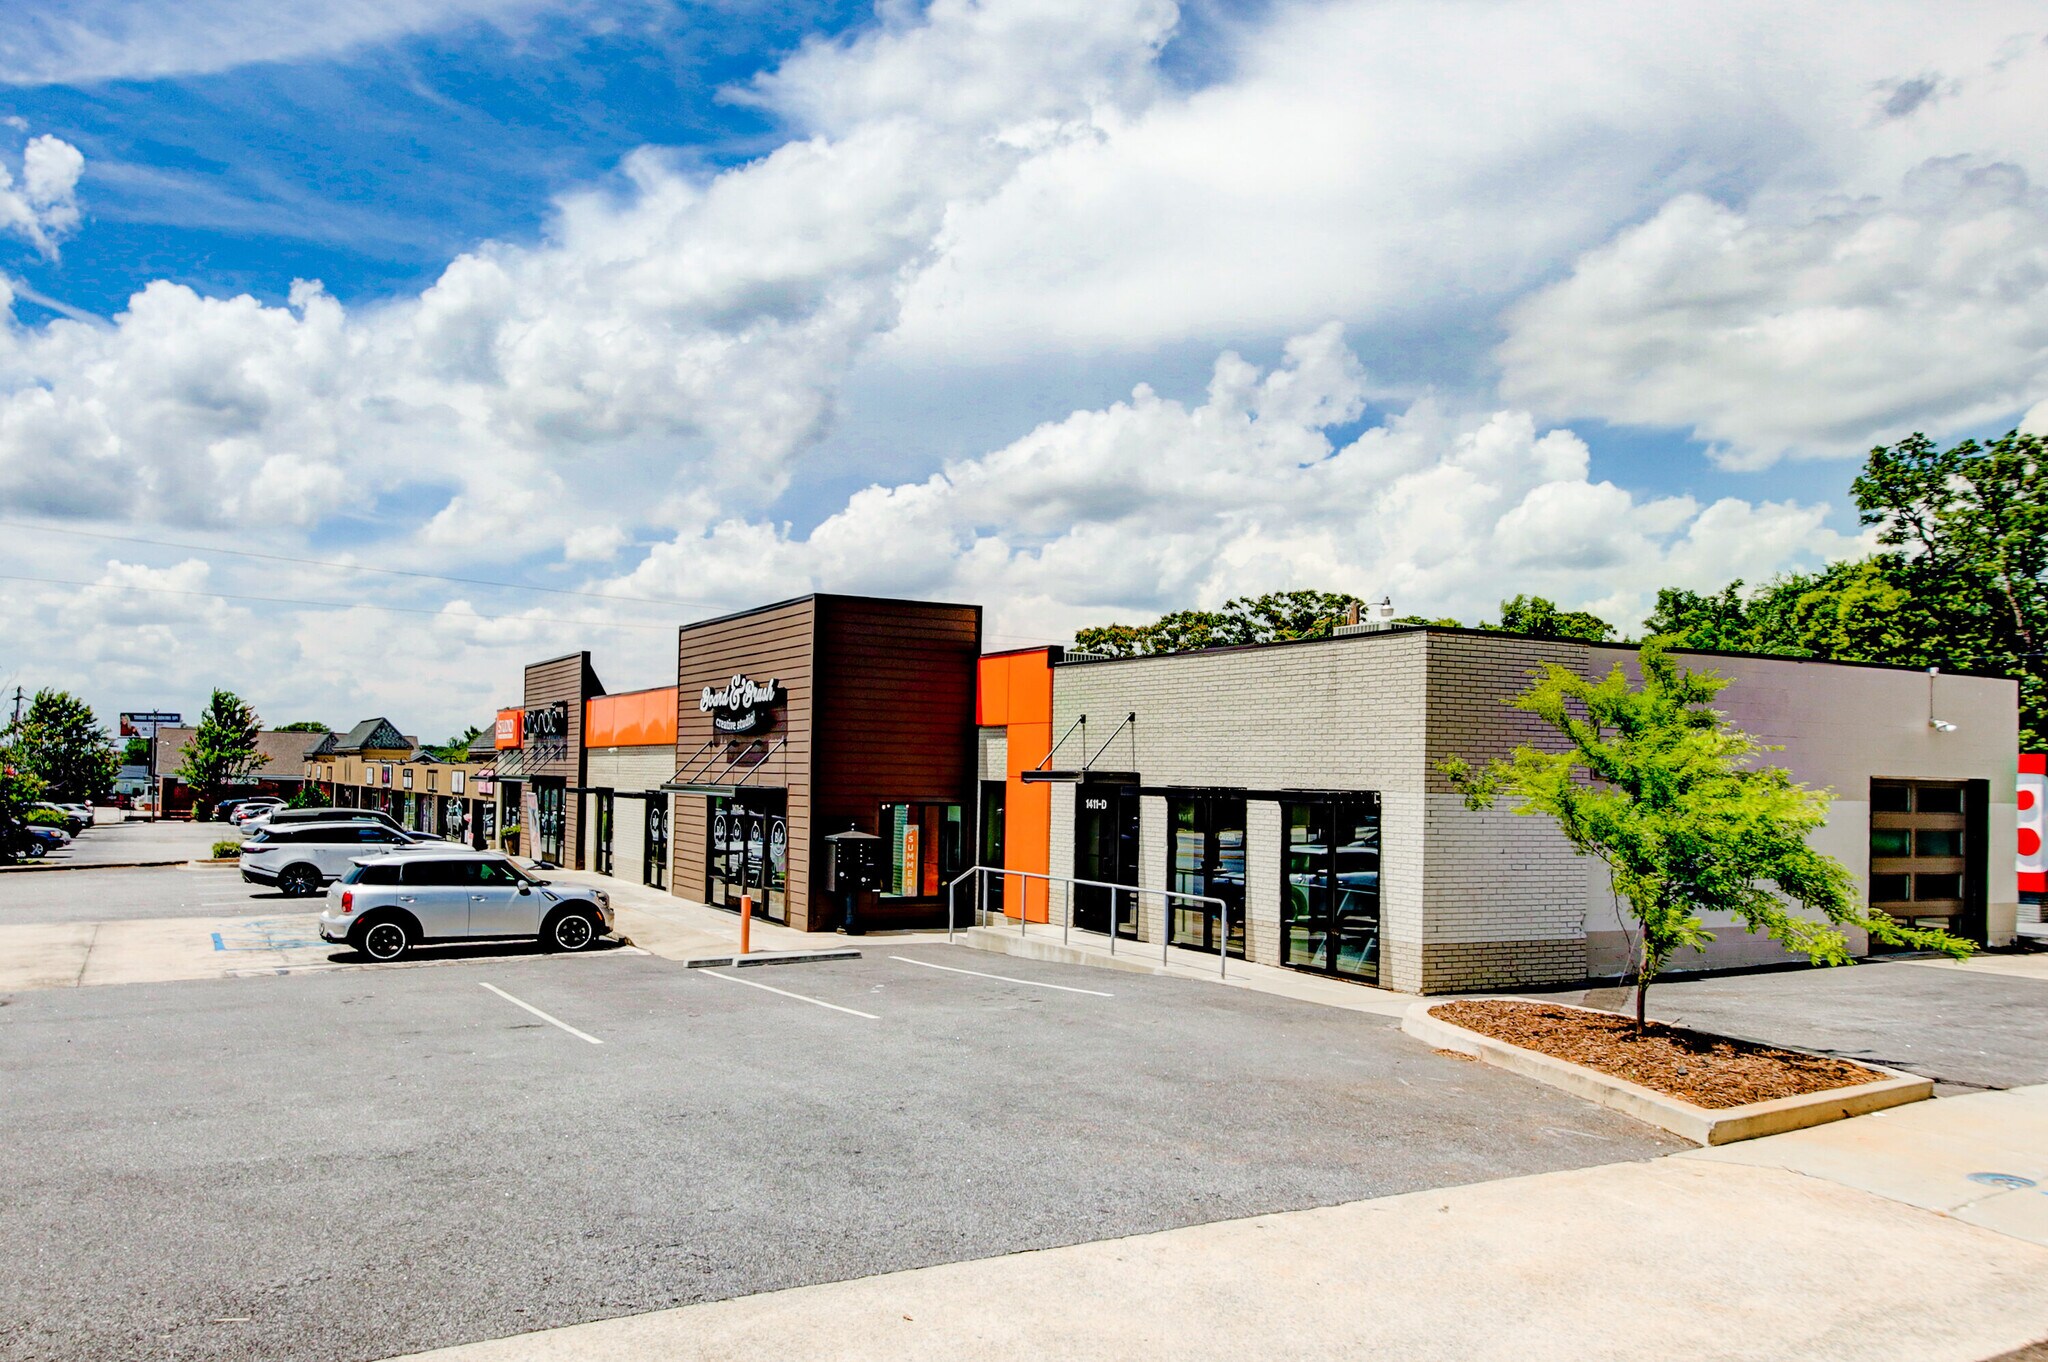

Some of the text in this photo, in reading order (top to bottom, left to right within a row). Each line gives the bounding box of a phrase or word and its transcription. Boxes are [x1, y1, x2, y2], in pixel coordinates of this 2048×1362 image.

[700, 673, 776, 712] Board & Brush
[715, 717, 737, 731] creative
[1085, 798, 1107, 810] 1411-D
[906, 835, 914, 886] SUMMER
